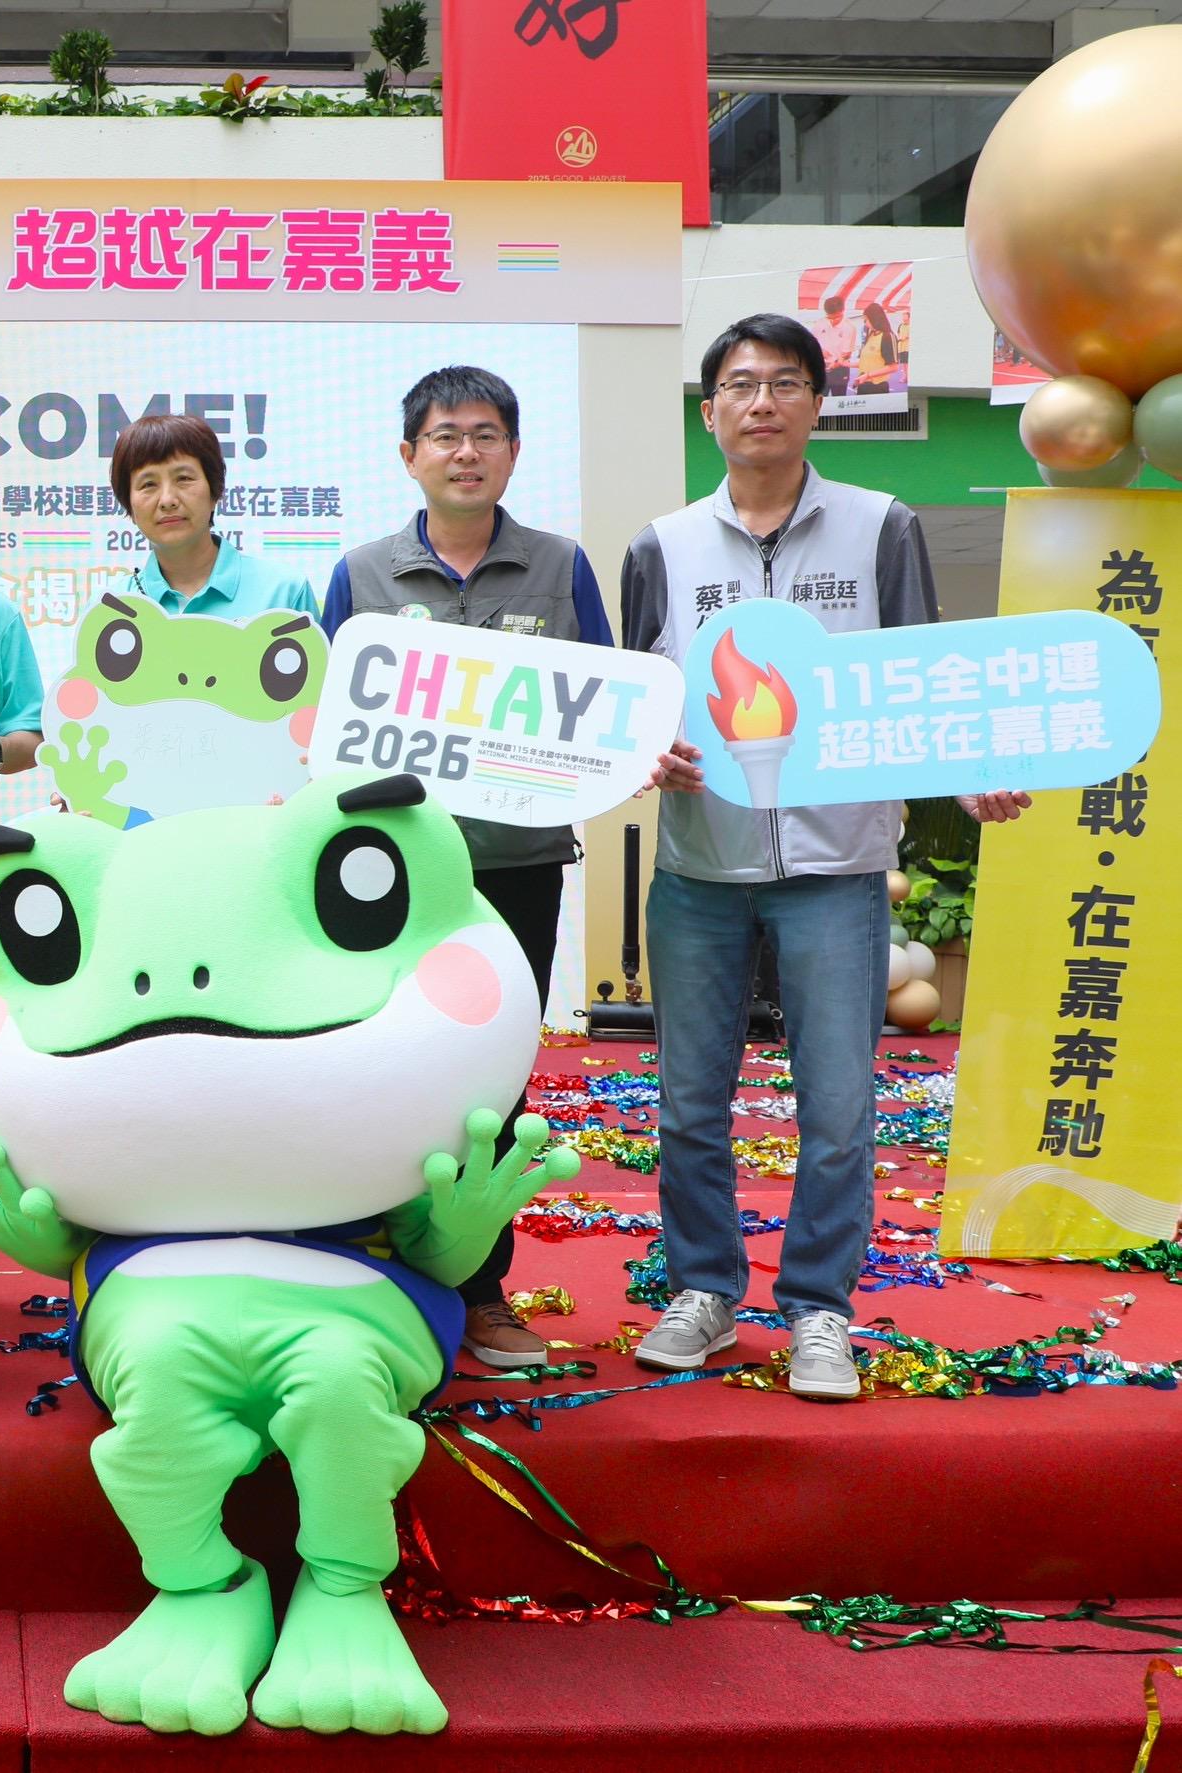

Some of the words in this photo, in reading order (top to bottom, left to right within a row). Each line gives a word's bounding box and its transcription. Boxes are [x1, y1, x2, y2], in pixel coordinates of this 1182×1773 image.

[107, 530, 152, 551] 202
[793, 580, 858, 603] 陳冠廷
[348, 643, 648, 752] CHIAYI
[812, 640, 1101, 710] 115全中運
[335, 719, 473, 781] 2026
[479, 740, 612, 768] 中華民國115年全國中等學校運動會
[815, 698, 1112, 771] 超越在嘉義
[477, 749, 508, 760] NATIONAL
[509, 754, 533, 764] MIDDLE
[534, 758, 556, 768] SCHOOL
[557, 761, 588, 773] ATHLETIC
[588, 766, 611, 776] GAMES
